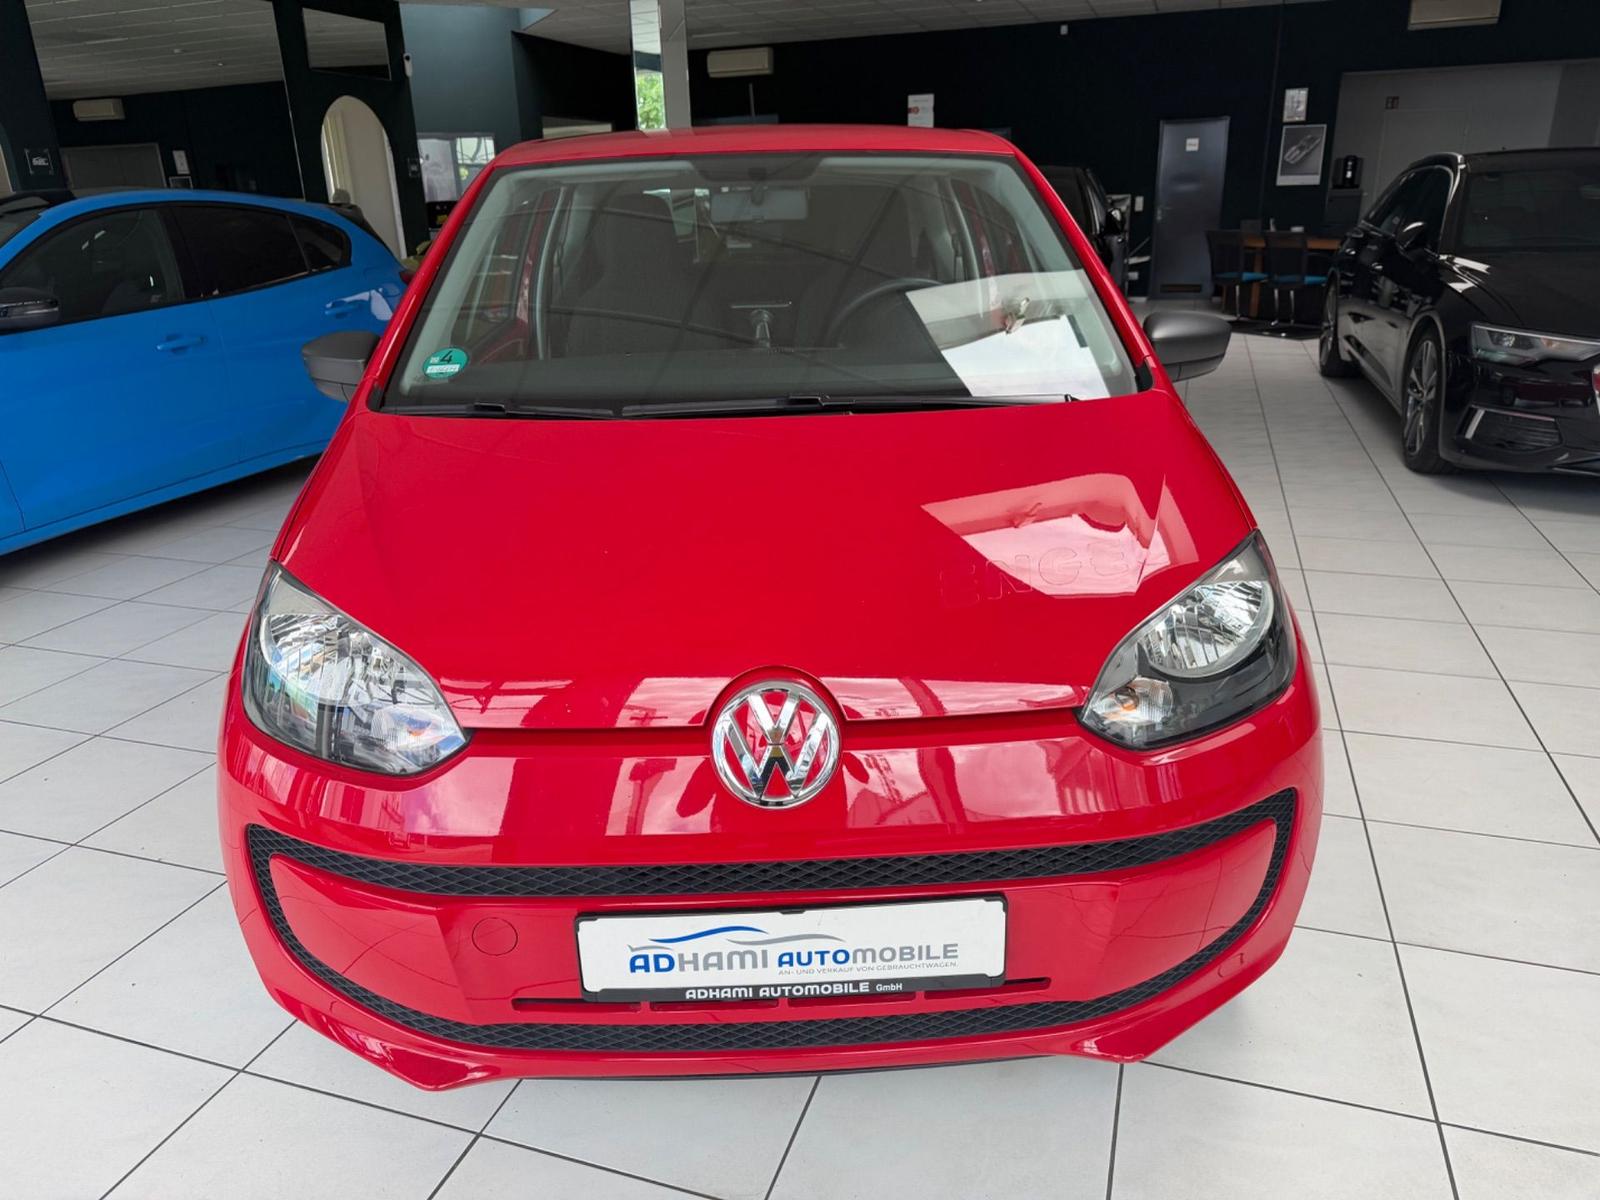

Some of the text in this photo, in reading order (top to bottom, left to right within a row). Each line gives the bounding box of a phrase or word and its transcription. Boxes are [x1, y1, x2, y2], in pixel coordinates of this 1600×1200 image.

[440, 350, 453, 364] 4
[630, 943, 959, 973] ADHAMI AUTOMOBILE
[796, 967, 816, 975] UND
[816, 966, 854, 974] VERKAUF
[856, 965, 875, 973] VON
[685, 982, 903, 1000] ADHAMI AUTOMOBILE GmbH
